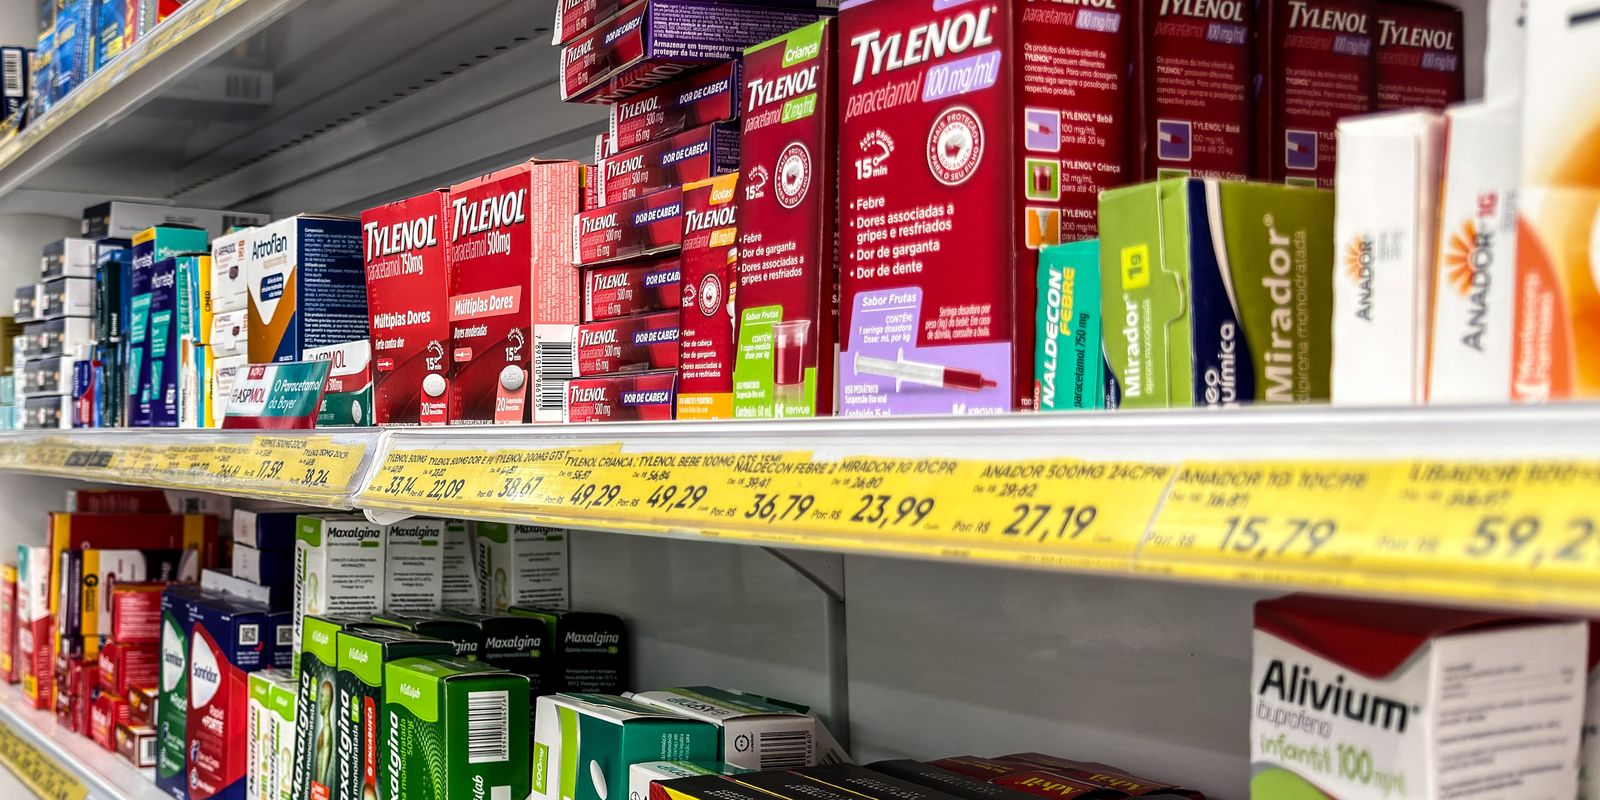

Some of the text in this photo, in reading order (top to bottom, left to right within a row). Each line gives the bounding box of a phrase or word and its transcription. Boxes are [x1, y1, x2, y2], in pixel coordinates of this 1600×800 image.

[1159, 0, 1244, 22] TYLENOL
[1288, 1, 1368, 34] TYLENOL
[654, 40, 735, 52] Armazenar em temperatura
[1378, 19, 1454, 50] TYLENOL
[654, 49, 678, 57] proteger
[689, 50, 698, 58] luz
[786, 42, 817, 62] Criança
[851, 7, 992, 86] TYLENOL
[679, 80, 728, 104] DOR DE CABEÇA
[748, 66, 817, 112] TYLENOL
[844, 54, 996, 124] paracetamol 100 mg/mL
[620, 96, 659, 122] TYLENOL
[744, 104, 782, 135] paracetamol
[1096, 114, 1113, 124] Bebê
[932, 112, 978, 144] MAIS PROTEÇÃO
[1062, 124, 1072, 134] 100
[860, 132, 875, 149] Ação
[1062, 136, 1105, 146] para até 20 kg
[855, 158, 888, 180] 15 min
[932, 146, 978, 181] PARA O SEU FILHO
[452, 188, 526, 242] TYLENOL
[856, 196, 886, 211] Febre
[685, 207, 737, 235] TYLENOL
[856, 204, 954, 229] Dores associadas a
[364, 215, 437, 263] TYLENOL
[742, 233, 762, 244] Febre
[856, 218, 952, 244] gripes e resfriados
[252, 232, 288, 262] Artroflan
[452, 232, 511, 264] paracetamol 500mg
[742, 242, 796, 259] Dor de garganta
[856, 239, 940, 261] Dor de garganta
[367, 252, 424, 281] paracetamol 750mg
[742, 262, 761, 272] Dores
[762, 256, 798, 270] associadas
[856, 260, 924, 279] Dor de dente
[1127, 253, 1143, 280] 1g
[742, 266, 802, 286] gripes e resfriados
[1356, 240, 1372, 322] ANADOR
[862, 294, 917, 307] Sabor Frutas
[1060, 266, 1076, 336] FEBRE
[1462, 232, 1492, 352] ANADOR
[454, 294, 513, 316] Múltiplas Dores
[1294, 230, 1310, 402] dipirona monoidratada
[374, 310, 431, 330] Múltiplas Dores
[1042, 268, 1062, 408] NALDECON
[1074, 312, 1090, 408] paracetamol 750 mg
[282, 378, 323, 392] Paracetamol
[570, 386, 606, 404] TYLENOL
[278, 396, 297, 412] Bayer
[624, 394, 636, 403] DOR
[636, 393, 645, 402] DE
[645, 392, 668, 404] CABEÇA
[386, 454, 409, 462] TYLENOL
[496, 454, 522, 464] TYLENOL
[524, 452, 548, 462] 200MG
[566, 456, 632, 468] TYLENOL CRIANCA
[639, 456, 735, 467] TYLENOL BEBE 100MG
[734, 462, 826, 474] NALDECON FEBRE
[838, 460, 895, 474] MIRADOR
[912, 461, 958, 475] 10CPR
[256, 460, 284, 480] 17,59
[980, 464, 1169, 480] ANADOR 500MG 24CPR
[385, 476, 418, 495] 33,14
[426, 479, 466, 500] 22,09
[498, 476, 544, 500] 38,67
[570, 484, 621, 510] 49,29
[646, 485, 708, 512] 49,29
[744, 494, 815, 523] 36,79
[850, 494, 935, 529] 23,99
[327, 526, 380, 540] Maxalgina
[390, 526, 440, 540] Maxalgina
[1002, 504, 1097, 543] 27,19
[1218, 516, 1337, 561] 15,79
[1466, 514, 1600, 569] 59,2
[486, 635, 541, 650] Maxalgina
[565, 632, 619, 646] Maxalgina
[1258, 659, 1409, 734] Alivium
[1256, 701, 1332, 738] ibuprofeno
[306, 704, 315, 770] monoidratada
[1260, 732, 1374, 784] infantil 100
